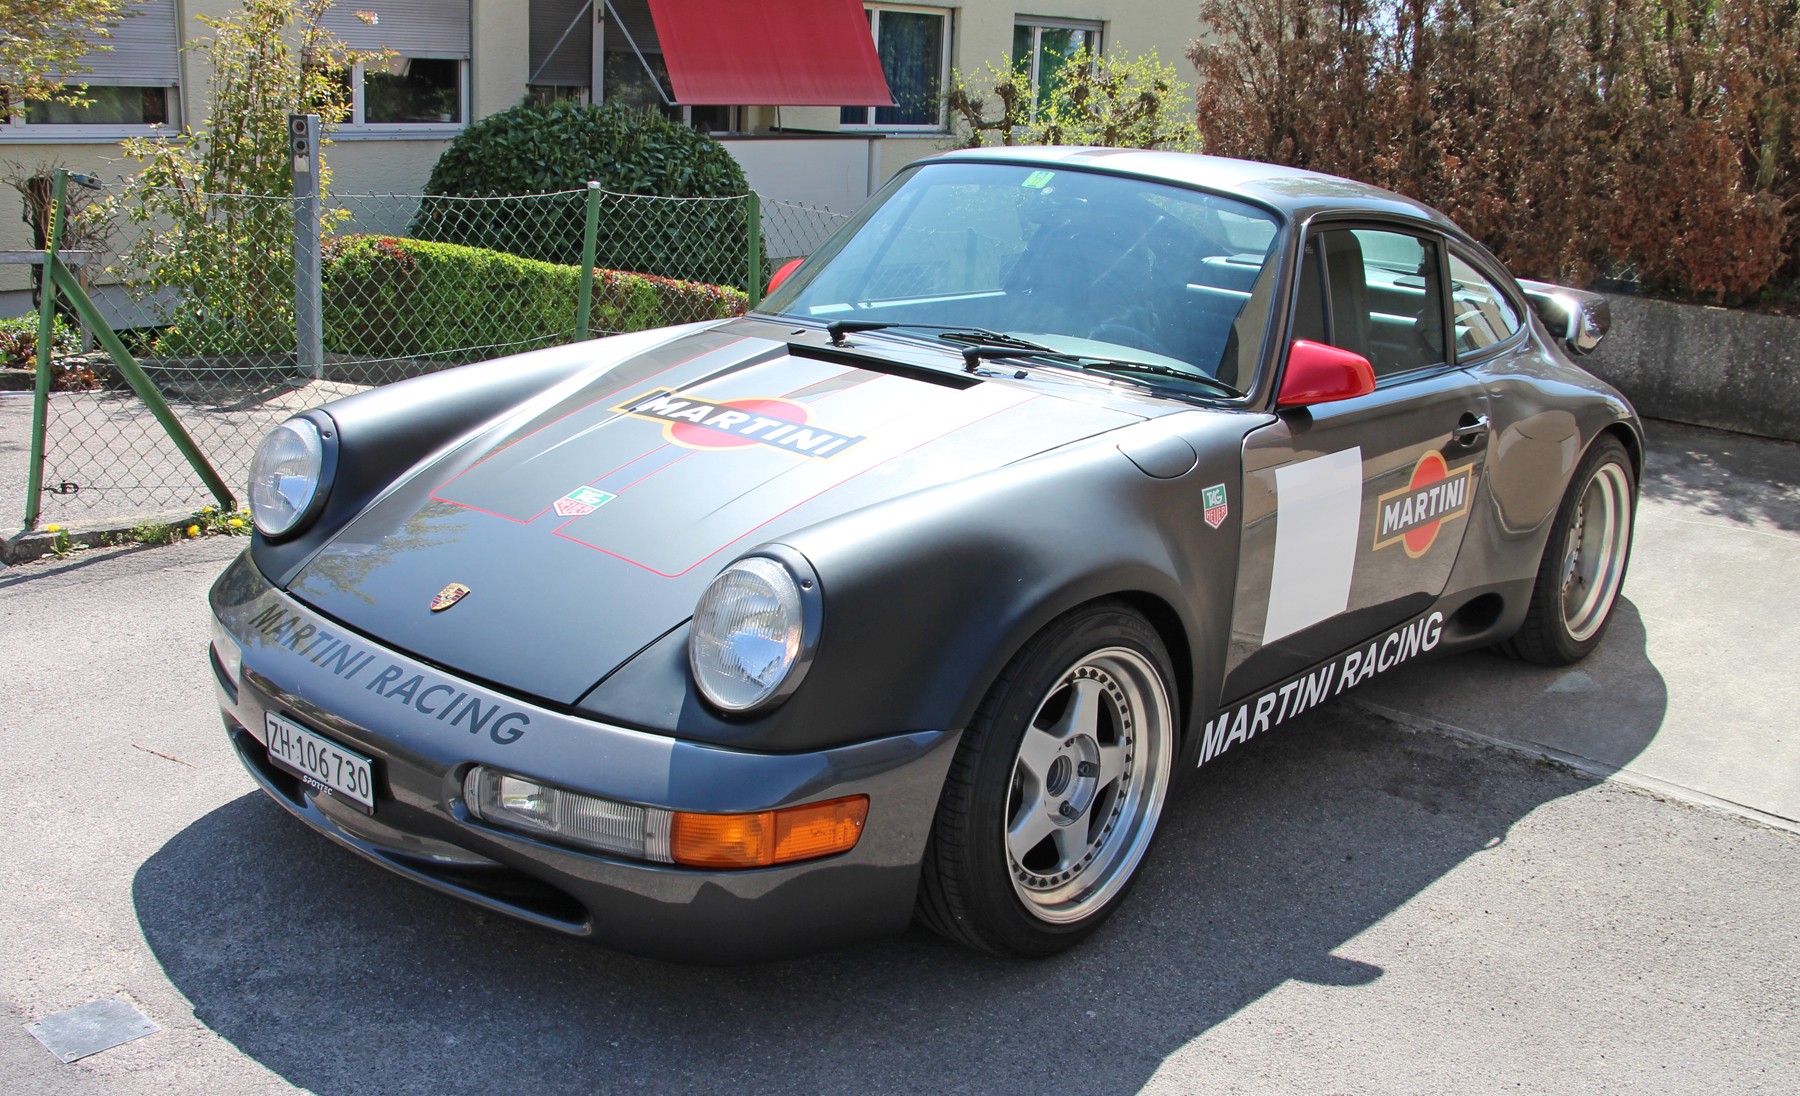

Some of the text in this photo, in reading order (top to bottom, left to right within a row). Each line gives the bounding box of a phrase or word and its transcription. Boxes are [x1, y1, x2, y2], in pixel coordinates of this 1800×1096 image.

[636, 396, 849, 456] MARTINI
[574, 489, 605, 505] TAG
[1206, 489, 1223, 507] TAG
[1206, 506, 1227, 525] HEUER
[1382, 477, 1466, 535] MARTINI
[248, 603, 531, 746] MARTINI RACING
[1197, 611, 1444, 769] MARTINI RACING
[302, 775, 333, 796] SPORTEC
